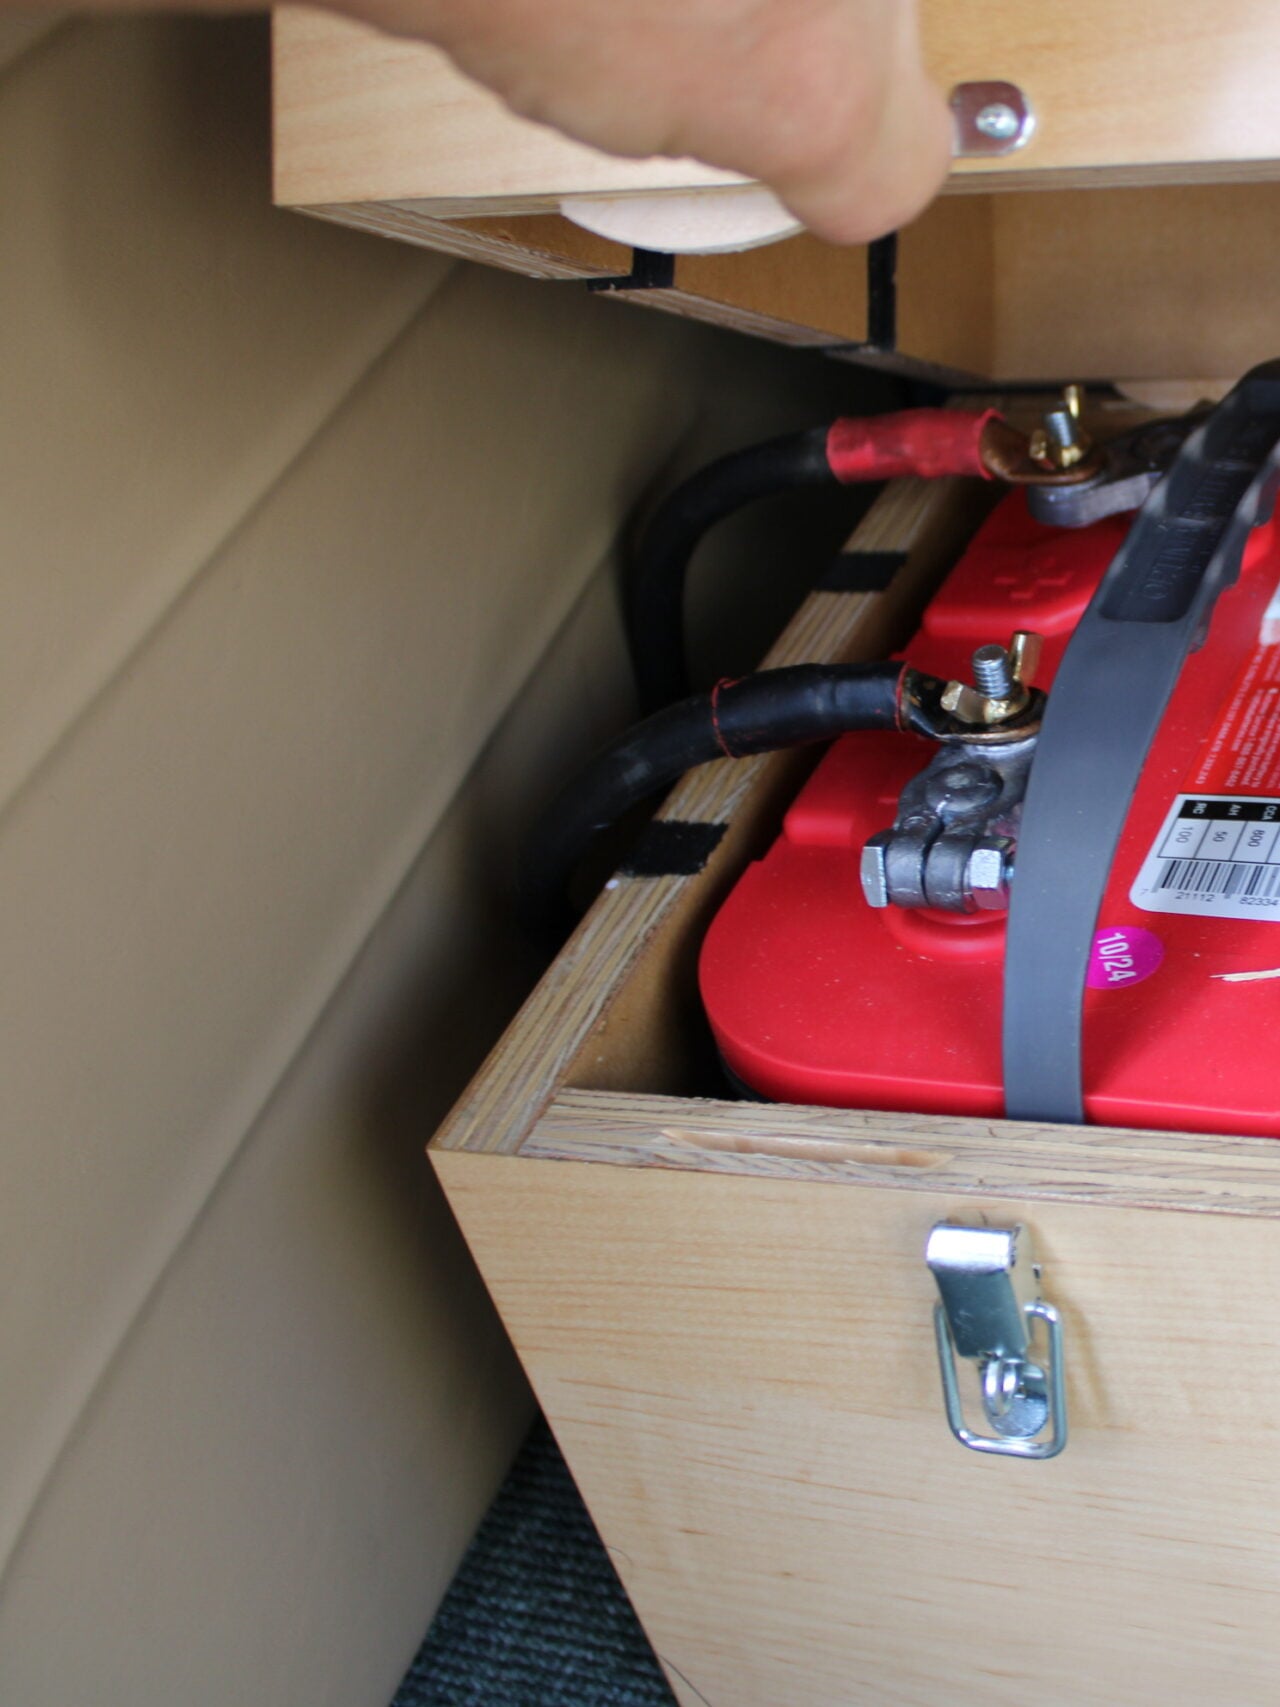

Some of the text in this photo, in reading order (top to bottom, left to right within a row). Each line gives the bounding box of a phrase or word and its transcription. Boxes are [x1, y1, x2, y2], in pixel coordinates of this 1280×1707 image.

[1175, 802, 1206, 843] RC 100
[1213, 804, 1240, 841] AH 50
[1248, 805, 1276, 846] CCA 800
[1175, 891, 1214, 901] 21112
[1239, 896, 1277, 905] 82334
[1096, 931, 1137, 982] 10/24
